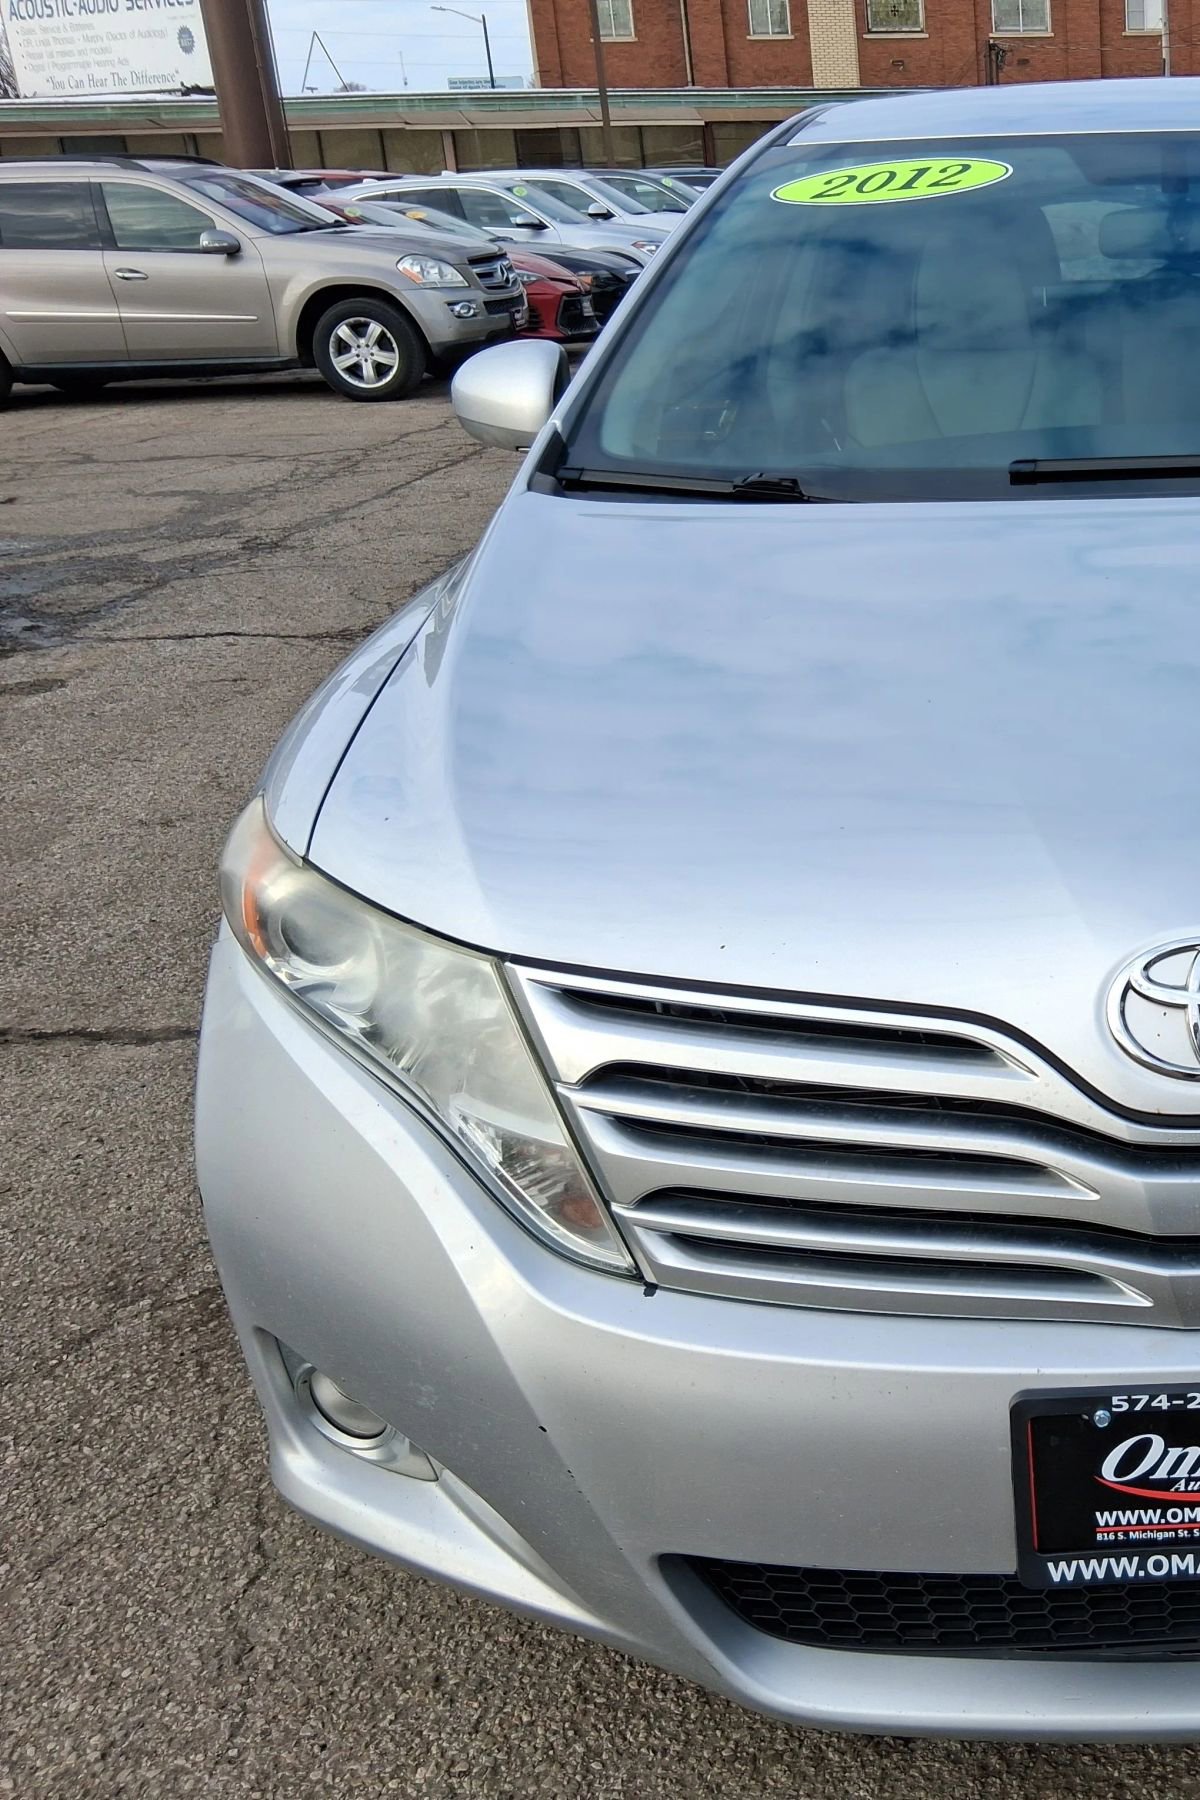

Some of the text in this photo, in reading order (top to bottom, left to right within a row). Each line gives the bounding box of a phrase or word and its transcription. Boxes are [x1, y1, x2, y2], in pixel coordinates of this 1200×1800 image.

[68, 75, 85, 89] Can
[87, 72, 108, 88] Hear
[110, 71, 128, 87] The
[809, 163, 972, 199] 2012
[1096, 1532, 1115, 1541] 816
[1117, 1532, 1127, 1540] S.
[1129, 1529, 1175, 1541] Michigan
[1178, 1529, 1191, 1538] St.
